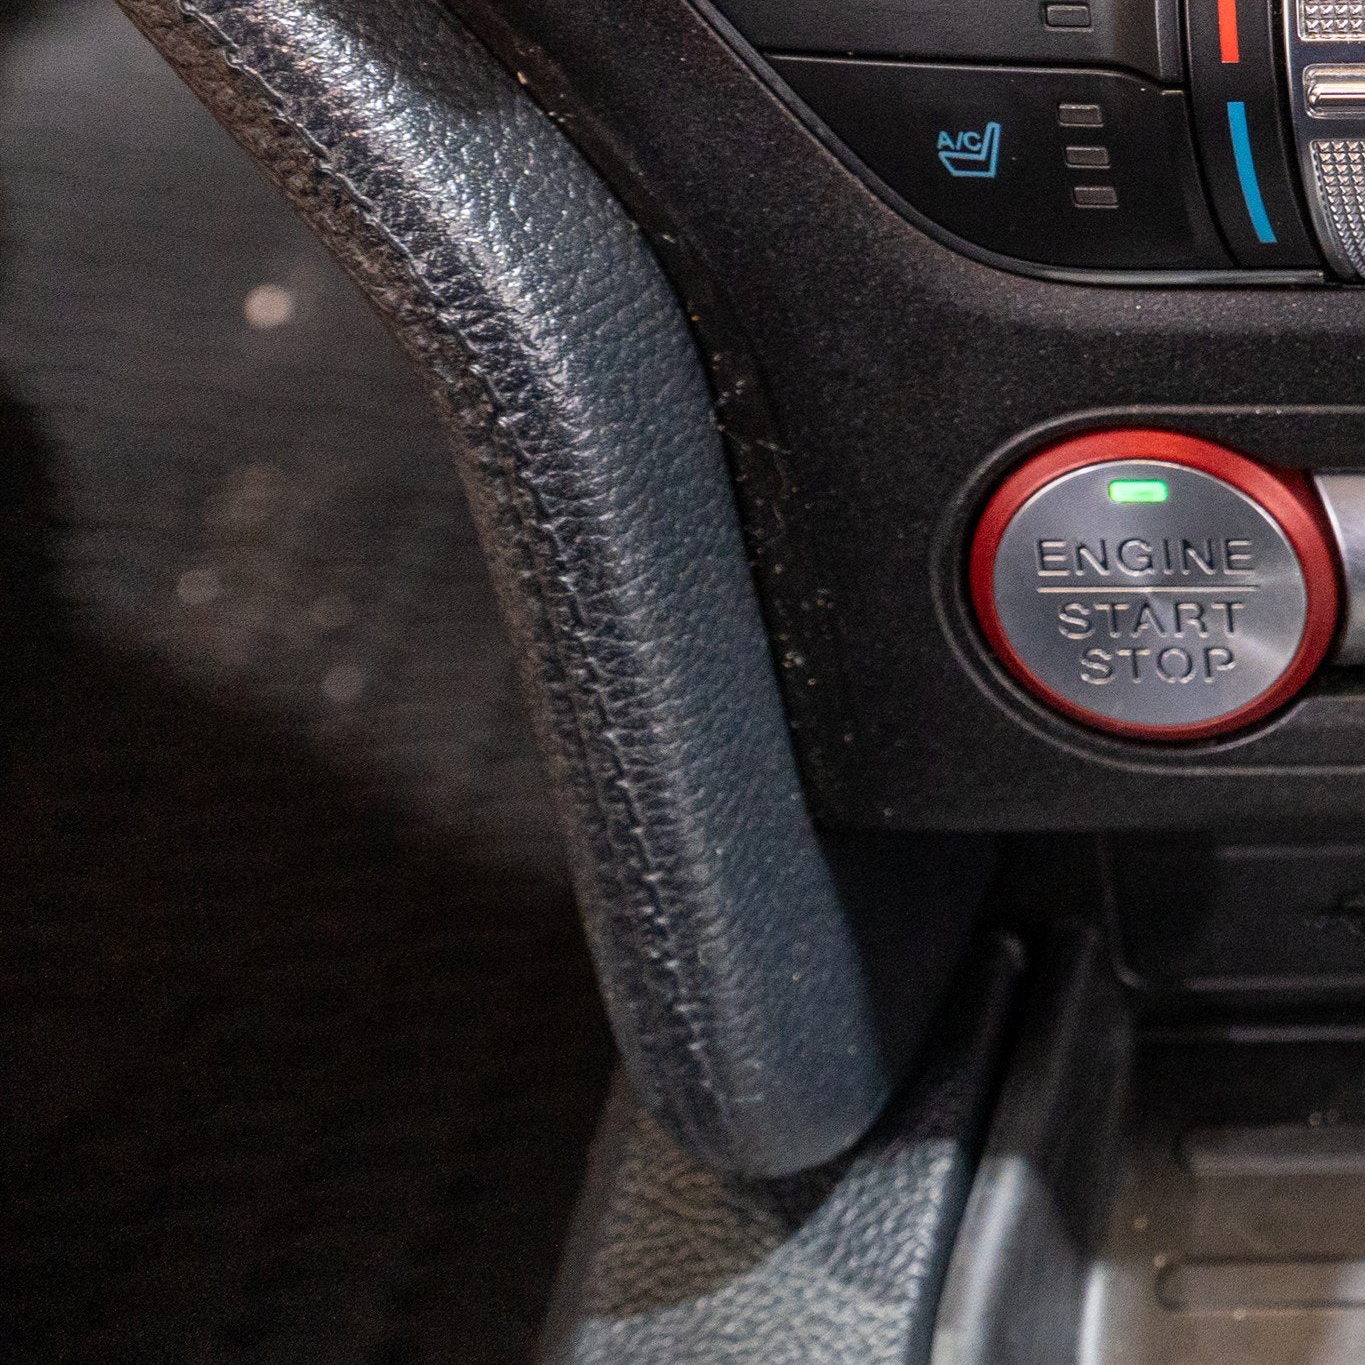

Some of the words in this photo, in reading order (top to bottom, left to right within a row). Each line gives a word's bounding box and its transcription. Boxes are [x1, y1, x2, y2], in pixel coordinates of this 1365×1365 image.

[937, 130, 984, 152] A/C
[1036, 538, 1256, 577] ENGINE
[1058, 602, 1245, 639] START
[1080, 647, 1237, 685] STOP
